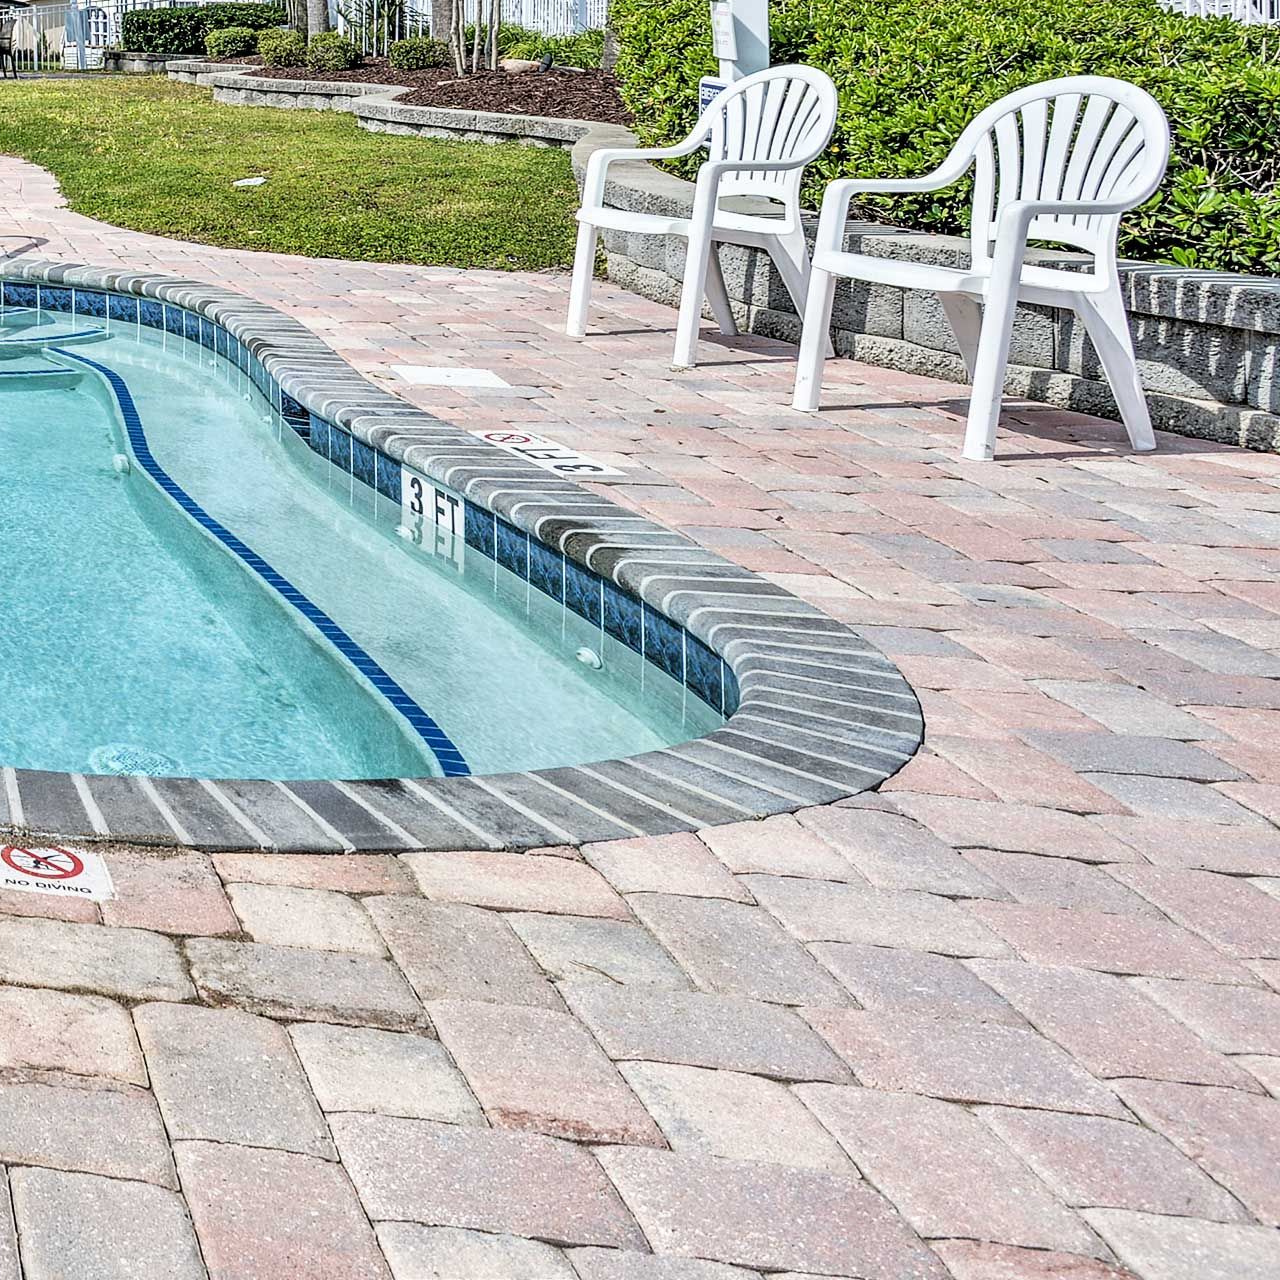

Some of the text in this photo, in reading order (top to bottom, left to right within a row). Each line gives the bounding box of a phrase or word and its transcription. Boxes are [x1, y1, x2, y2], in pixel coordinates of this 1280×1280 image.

[510, 446, 604, 472] 3 FT
[410, 477, 459, 535] 3 FT
[4, 878, 93, 894] NO DIVING
